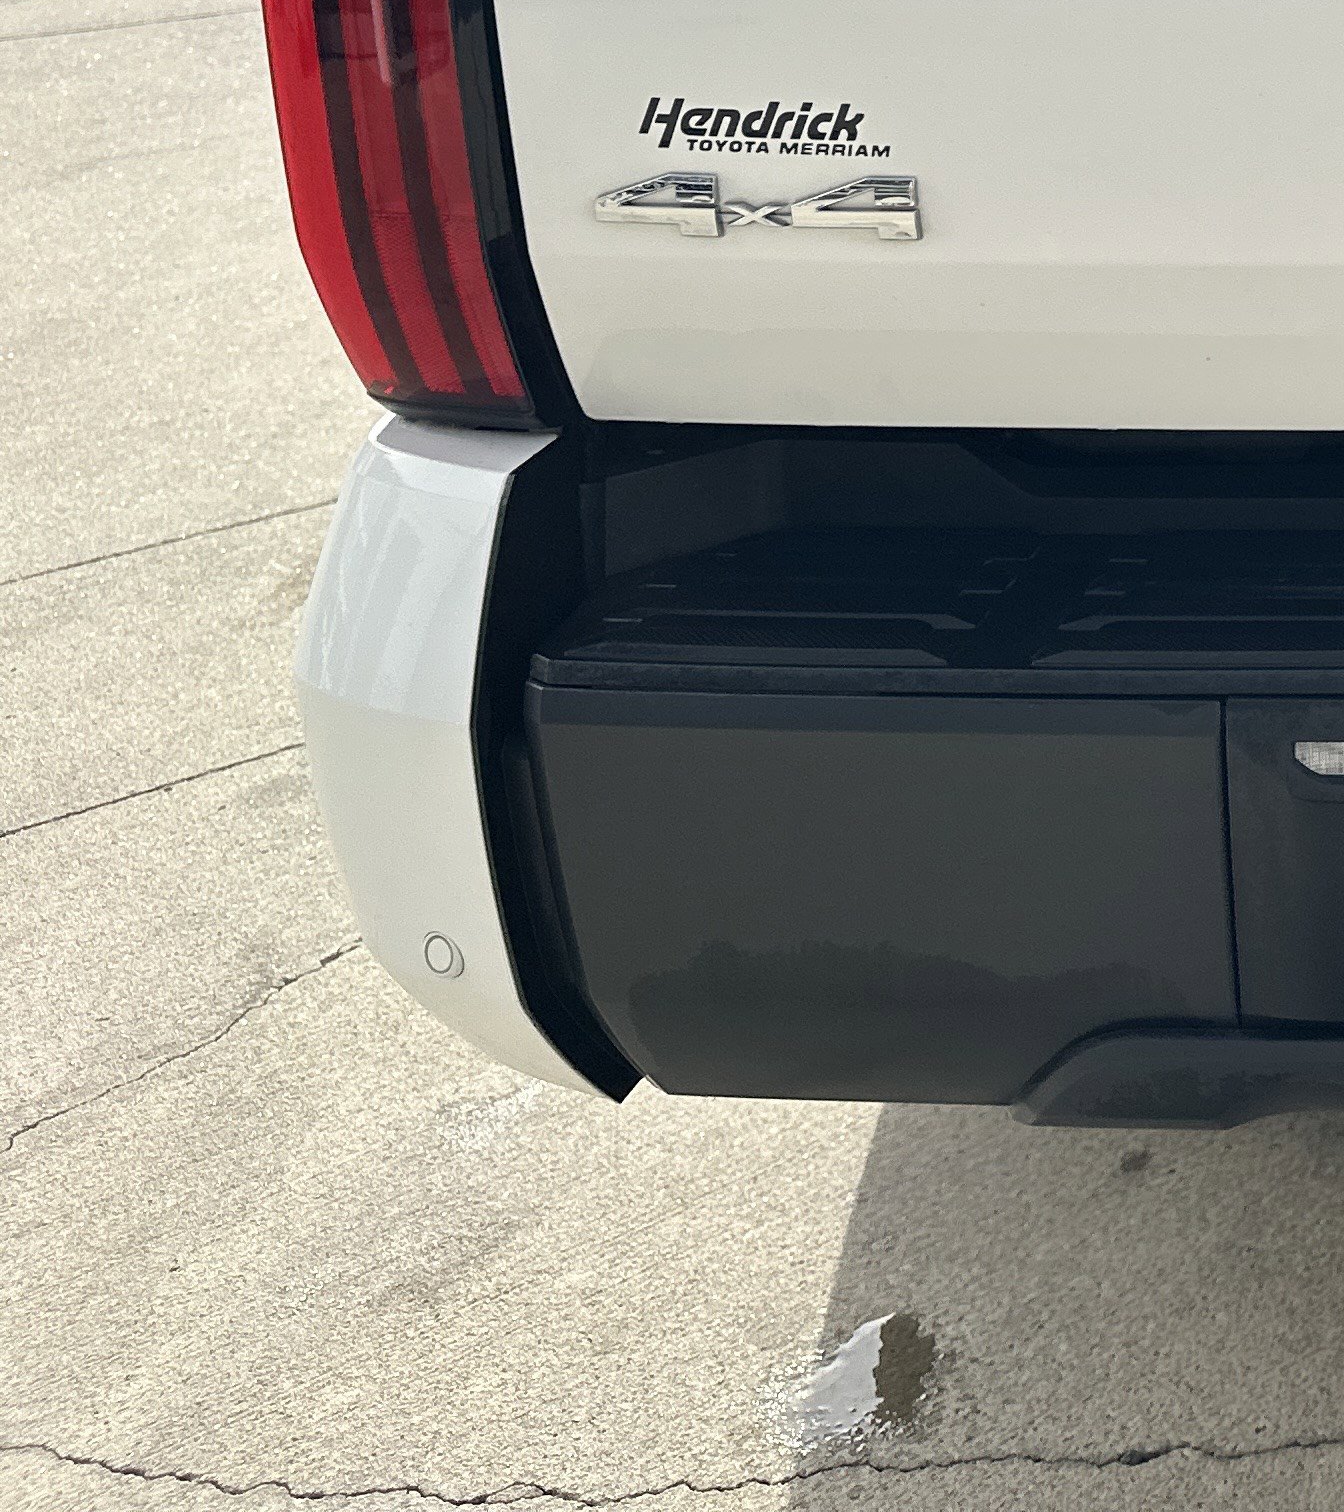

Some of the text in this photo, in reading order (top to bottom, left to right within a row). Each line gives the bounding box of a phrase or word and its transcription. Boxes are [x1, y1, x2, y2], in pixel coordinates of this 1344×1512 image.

[638, 96, 866, 148] Hendrick
[687, 138, 892, 158] TOYOTA MERRIAM
